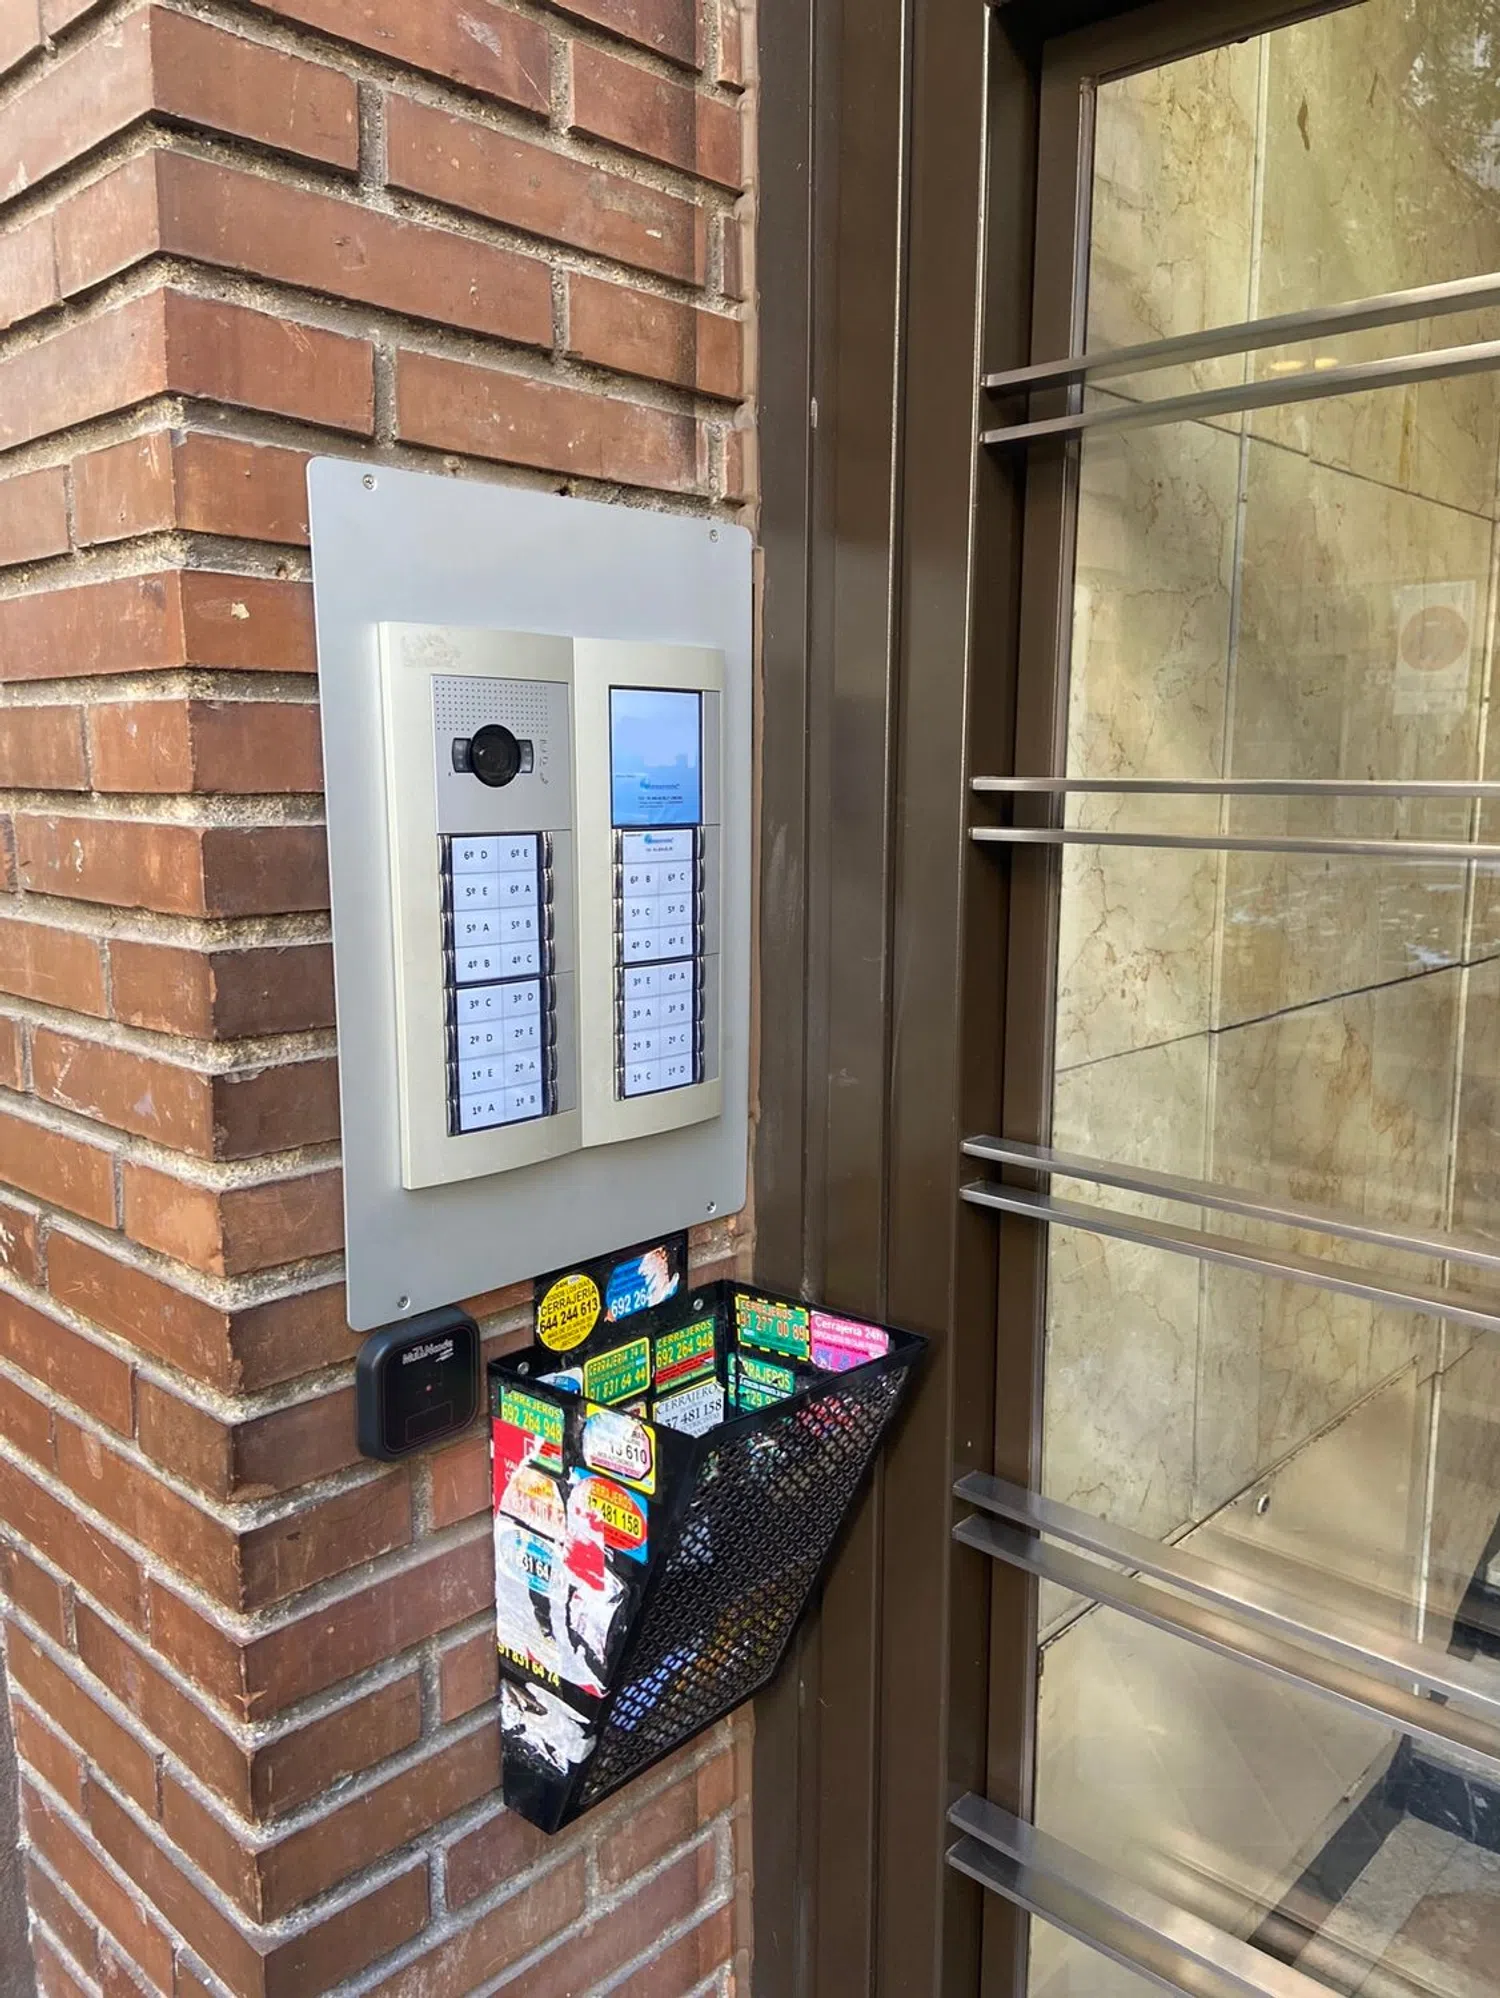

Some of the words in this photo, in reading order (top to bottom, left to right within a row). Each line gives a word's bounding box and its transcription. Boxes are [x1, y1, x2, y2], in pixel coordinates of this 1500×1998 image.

[540, 1316, 558, 1334] 644
[561, 1305, 578, 1324] 244
[581, 1298, 598, 1316] 613
[611, 1295, 631, 1317] 692
[656, 1321, 712, 1348] CERRAJEROS
[656, 1347, 674, 1368] 692
[677, 1339, 694, 1360] 264
[696, 1331, 714, 1351] 948
[502, 1402, 519, 1425] 692
[523, 1410, 540, 1433] 264
[544, 1418, 562, 1442] 948
[680, 1407, 701, 1424] 481
[703, 1399, 722, 1415] 158
[626, 1444, 648, 1465] 610
[591, 1481, 633, 1510] ERRAJEROS
[601, 1503, 618, 1526] 481
[622, 1513, 640, 1536] 158
